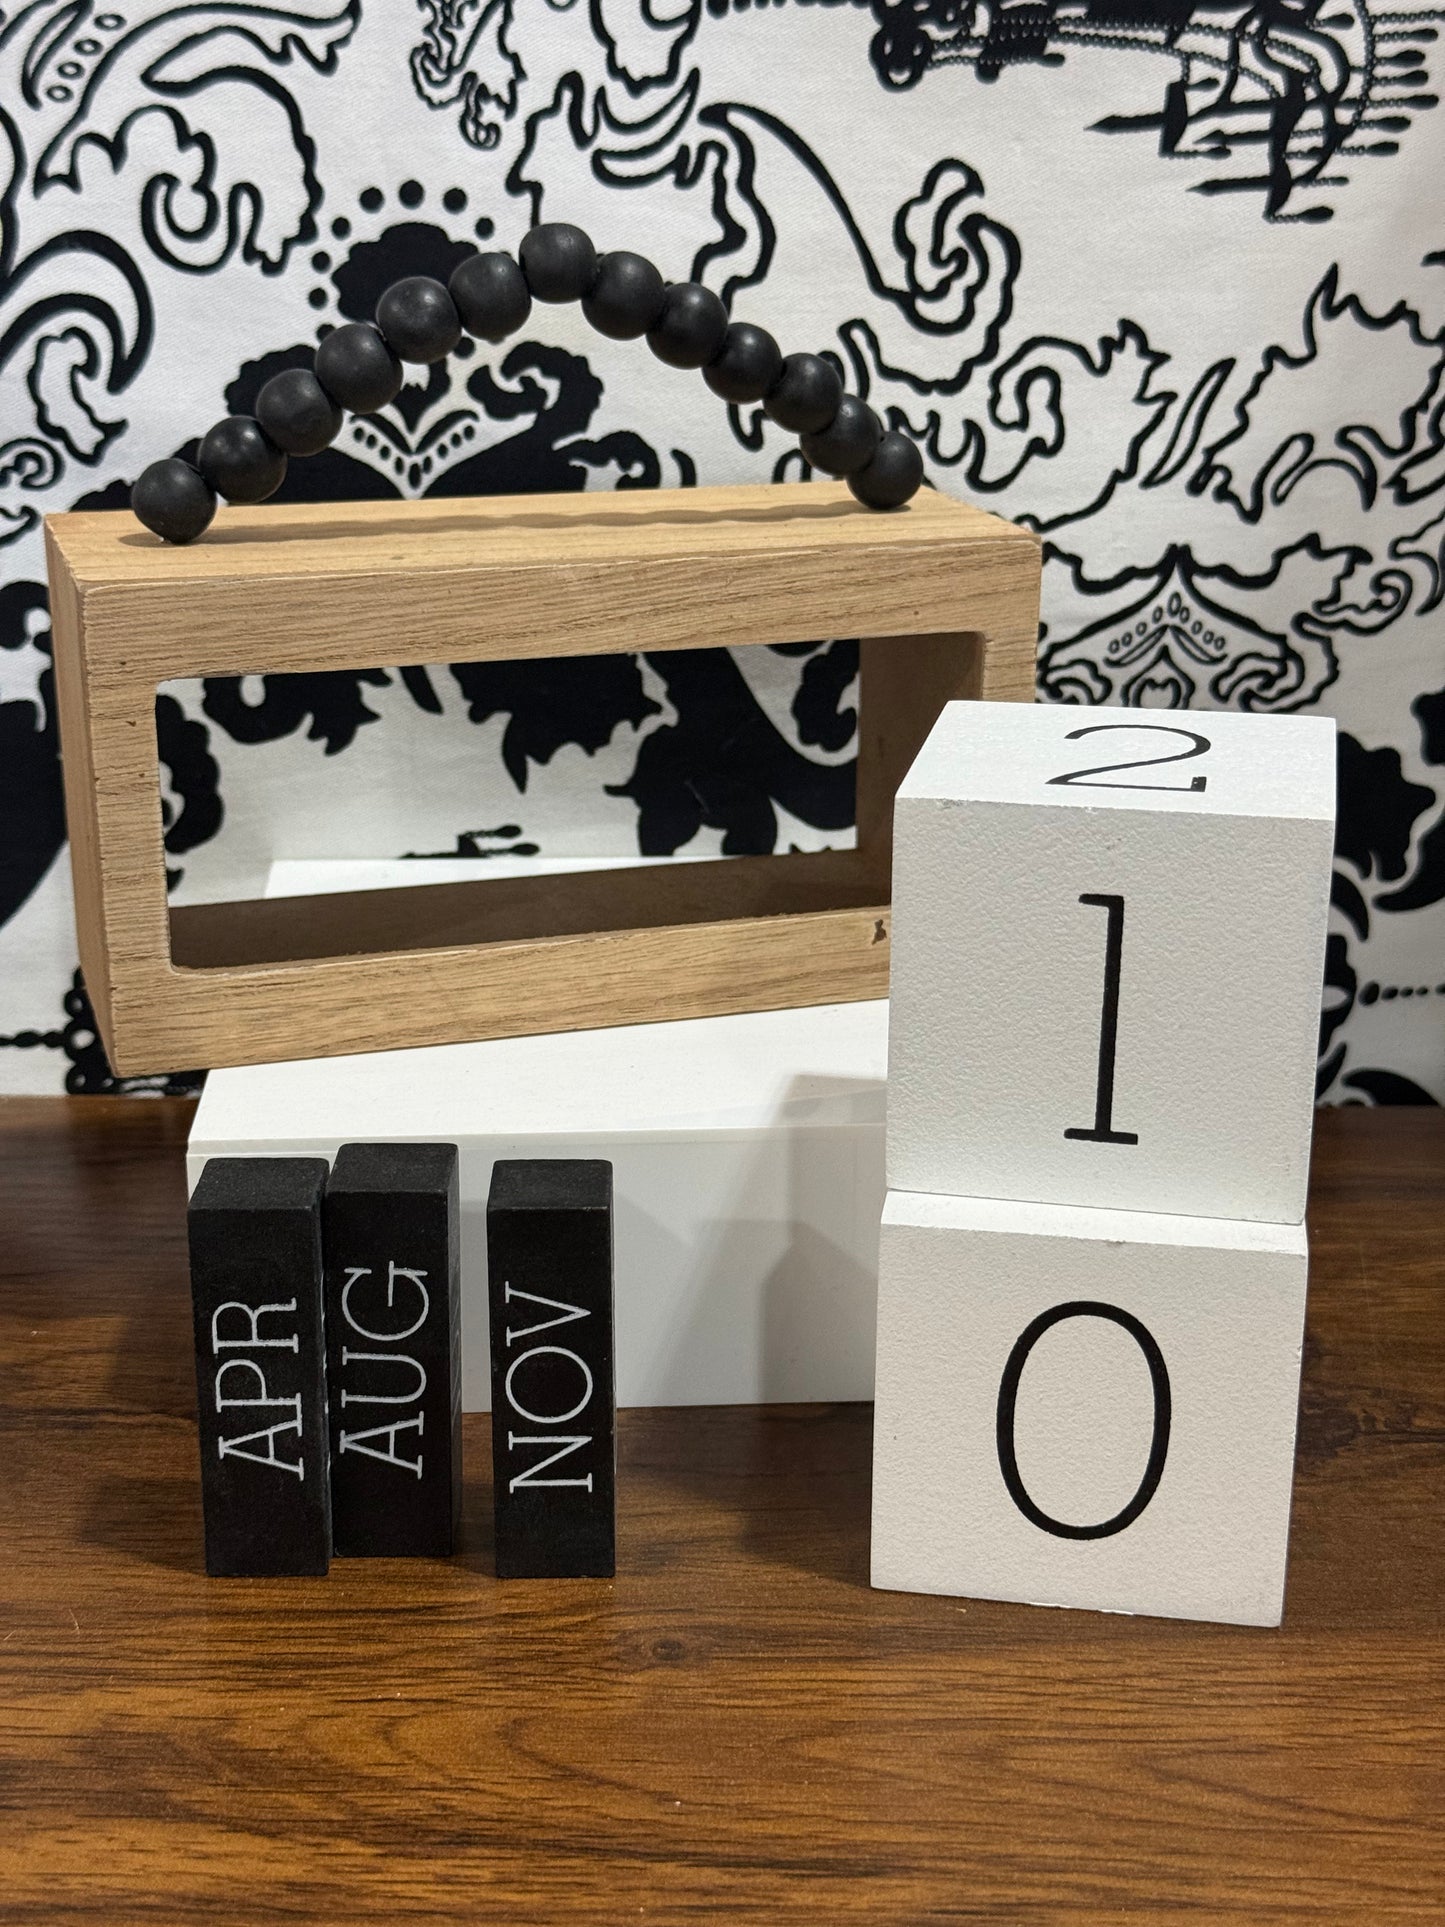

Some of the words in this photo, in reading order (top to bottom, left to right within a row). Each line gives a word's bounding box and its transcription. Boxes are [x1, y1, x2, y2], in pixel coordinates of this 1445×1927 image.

[1045, 724, 1212, 793] 2
[1063, 893, 1139, 1146] 1
[211, 1297, 305, 1481] APR
[339, 1260, 430, 1480] AUG
[504, 1280, 594, 1494] NOV
[996, 1300, 1172, 1541] 0
